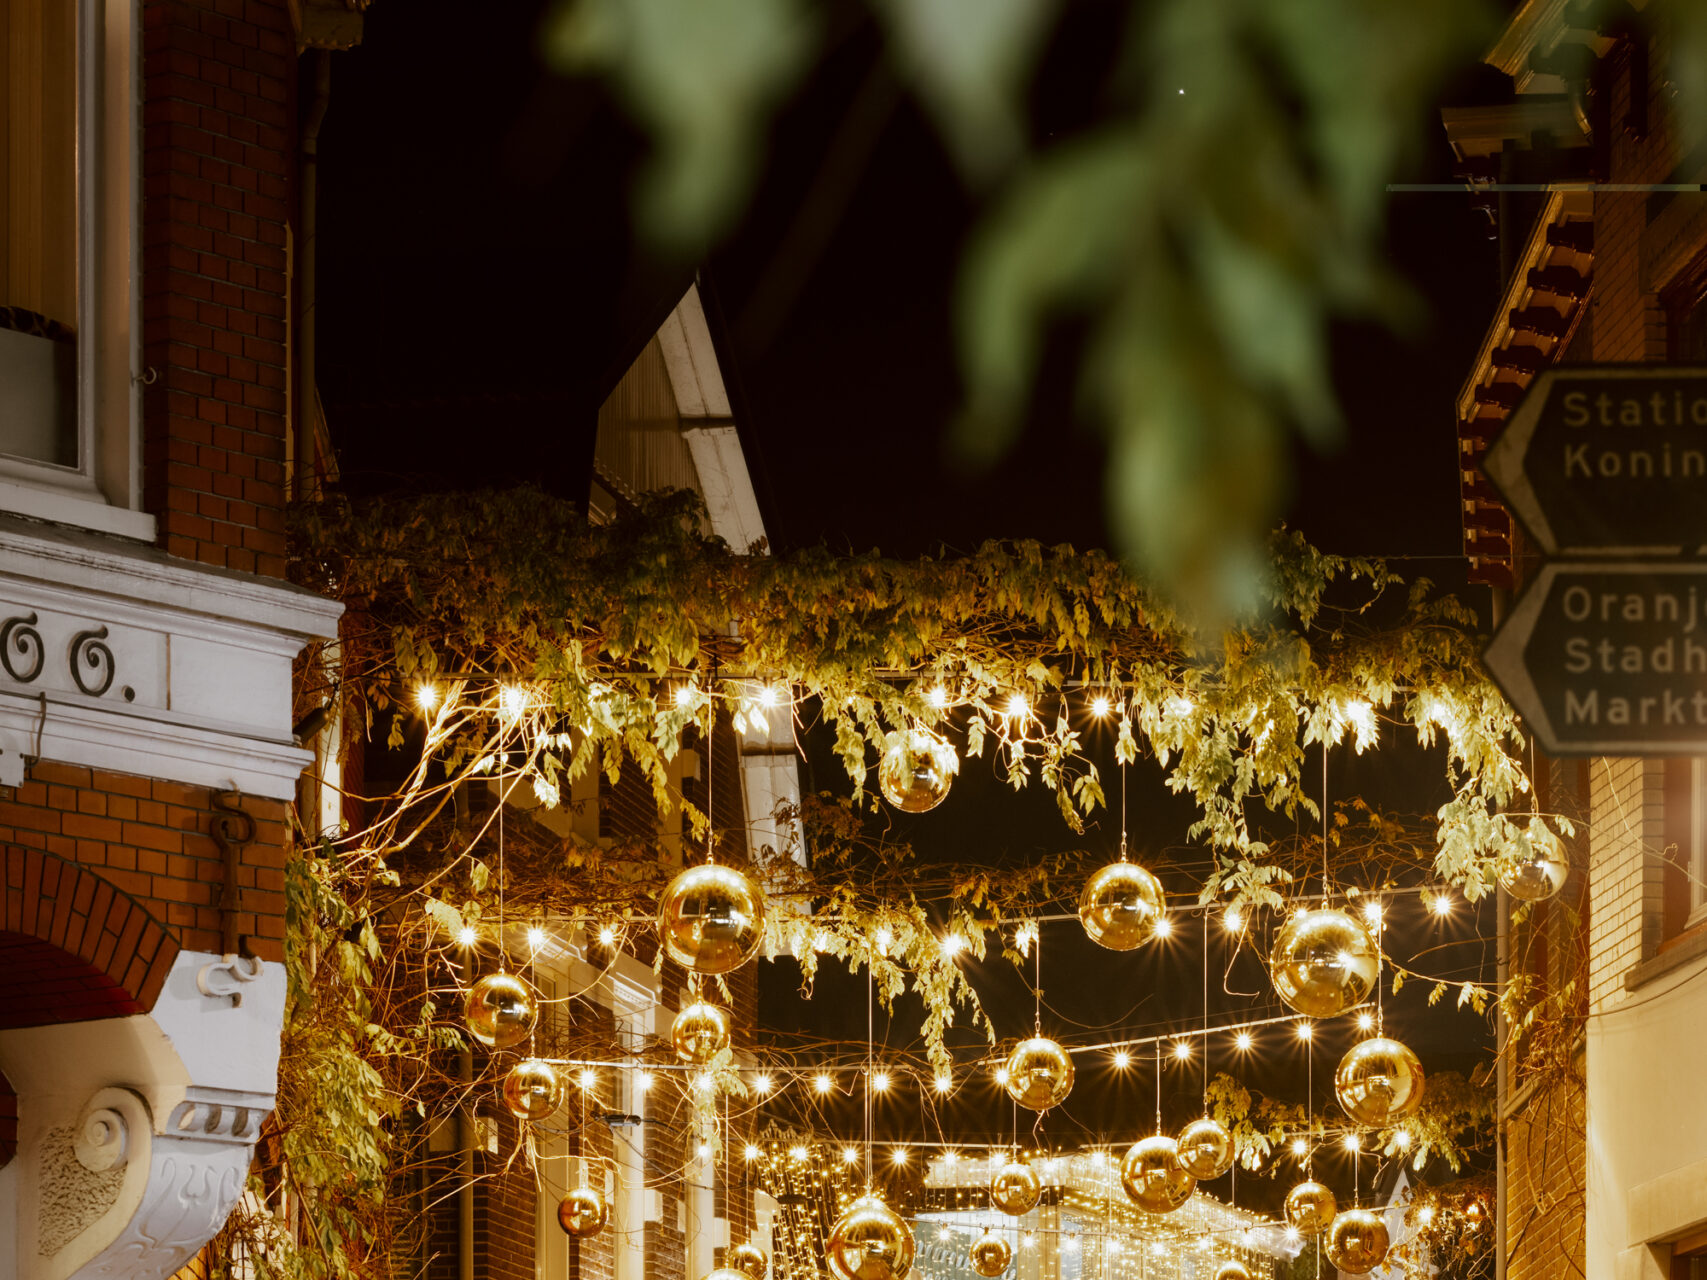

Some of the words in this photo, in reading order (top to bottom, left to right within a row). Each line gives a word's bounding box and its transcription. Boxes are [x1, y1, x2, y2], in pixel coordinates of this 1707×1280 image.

[1562, 585, 1707, 632] Oranj
[1565, 637, 1707, 674] Stadh
[1565, 689, 1707, 726] Markt
